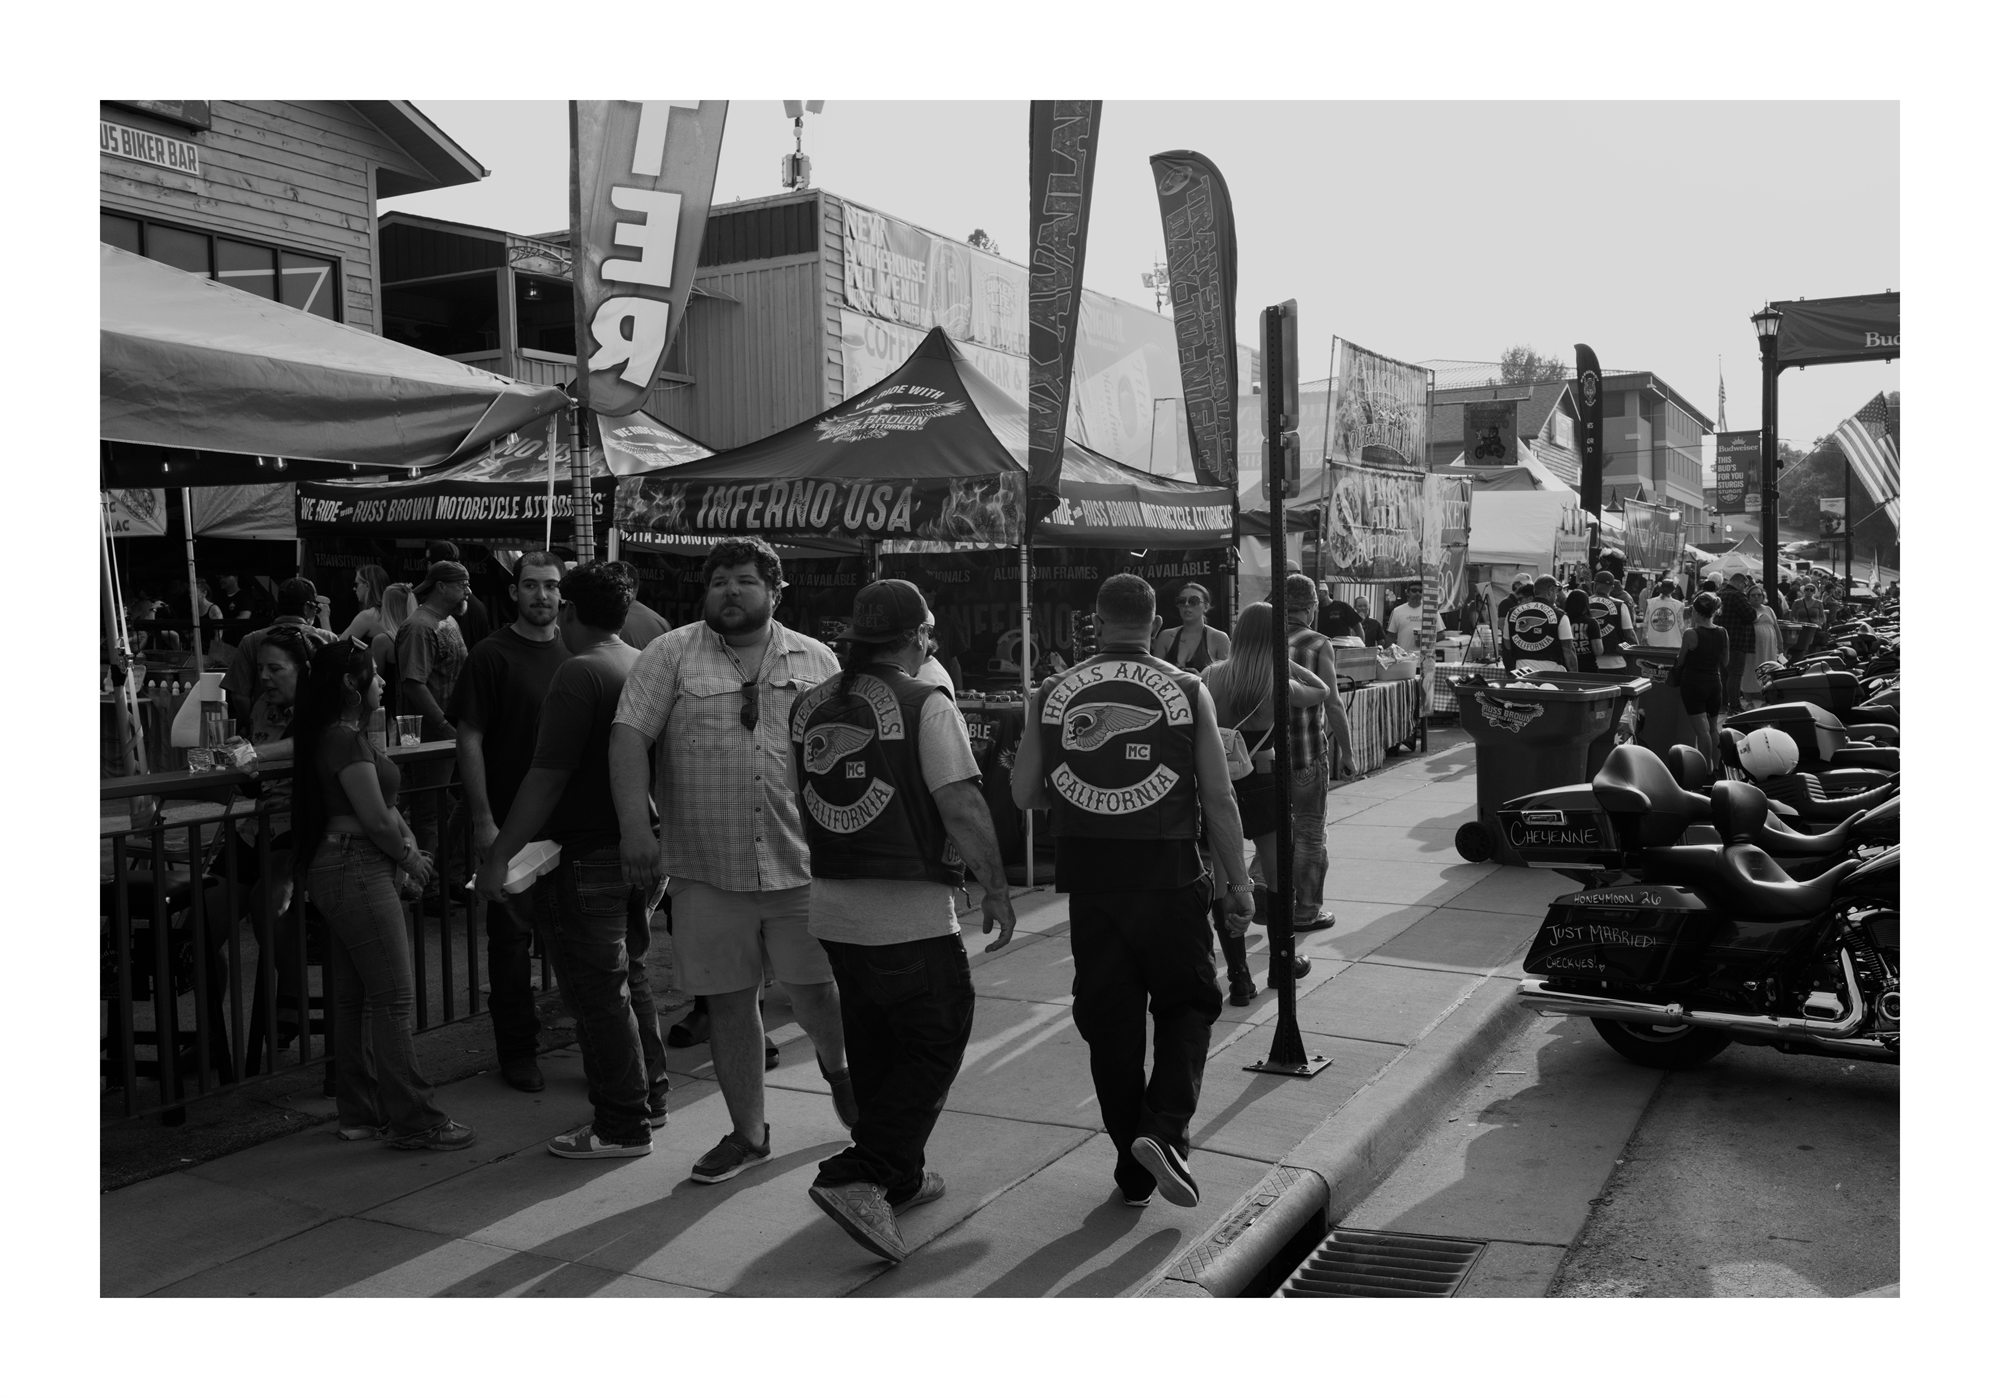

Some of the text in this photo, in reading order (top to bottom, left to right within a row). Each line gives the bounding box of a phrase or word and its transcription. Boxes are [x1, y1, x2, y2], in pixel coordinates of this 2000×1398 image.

[120, 127, 166, 165] BIKER
[167, 139, 198, 172] BAR
[1029, 100, 1092, 343] AVAILA
[880, 271, 921, 305] MENU
[877, 384, 909, 400] RIDE
[907, 384, 945, 400] WITH
[864, 414, 929, 426] BROWN
[1718, 444, 1759, 453] Budweiser
[1717, 464, 1737, 472] BUD'S
[1718, 456, 1733, 464] THIS
[1717, 472, 1744, 481] FOR YOU
[1717, 480, 1744, 489] STURGIS
[301, 497, 316, 521] WE
[315, 499, 344, 523] RIDE
[352, 499, 387, 523] RUSS
[387, 496, 436, 523] BROWN
[435, 495, 521, 520] MOTORCYCLE
[696, 479, 912, 532] INFERNO USA
[1080, 499, 1110, 527] RUSS
[1107, 499, 1144, 527] BROWN
[1139, 502, 1195, 530] MOTORCYCLE
[1191, 504, 1233, 531] ATTORNEYS
[1053, 565, 1099, 580] FRAMES
[1146, 560, 1212, 579] AVAILABLE
[806, 572, 857, 586] AVAILABLE
[1510, 602, 1558, 622] HELLS ANGELS
[1513, 636, 1552, 650] CALIFORNIA
[1044, 662, 1190, 722] HELLS ANGELS
[850, 675, 901, 738] ANGELS
[1482, 704, 1503, 717] RUSS
[1502, 709, 1531, 722] BROWN
[1127, 744, 1149, 759] MC
[847, 763, 865, 777] MC
[1055, 769, 1175, 813] CALIFORNIA
[805, 784, 890, 831] CALIFORNIA
[1510, 820, 1599, 847] CHEYENNE
[1573, 890, 1662, 906] HONEYMOON 26
[1545, 923, 1657, 949] JUST MARRIED!
